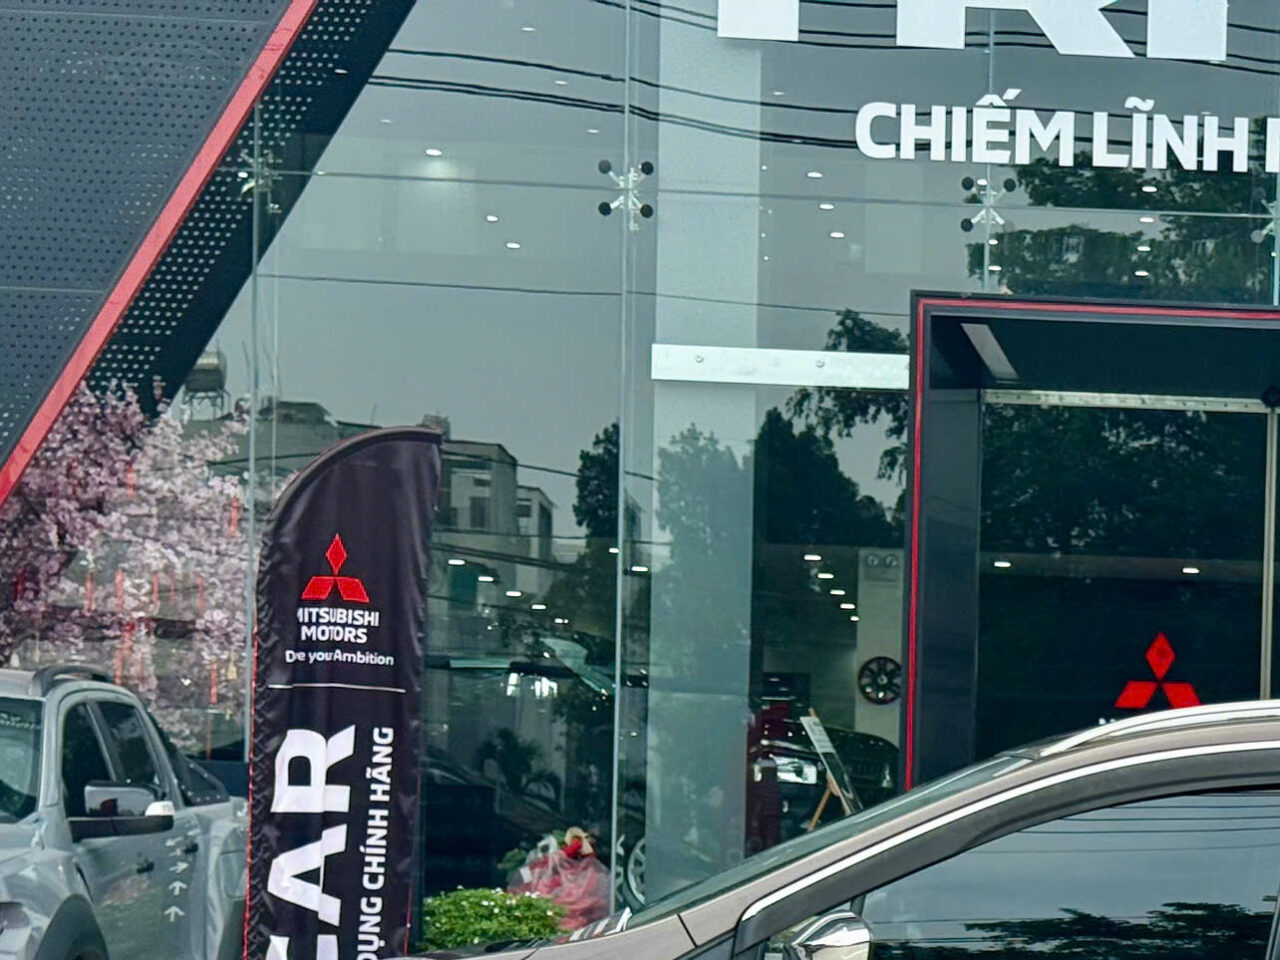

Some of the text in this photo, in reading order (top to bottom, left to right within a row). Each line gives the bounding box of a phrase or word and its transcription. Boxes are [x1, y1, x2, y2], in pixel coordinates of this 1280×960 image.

[855, 88, 1075, 167] CHIẾM
[1092, 97, 1248, 172] LĨNH
[301, 625, 368, 644] MOTORS
[333, 649, 395, 666] Ambition
[366, 727, 395, 802] HÃNG
[360, 809, 390, 891] CHÍNH
